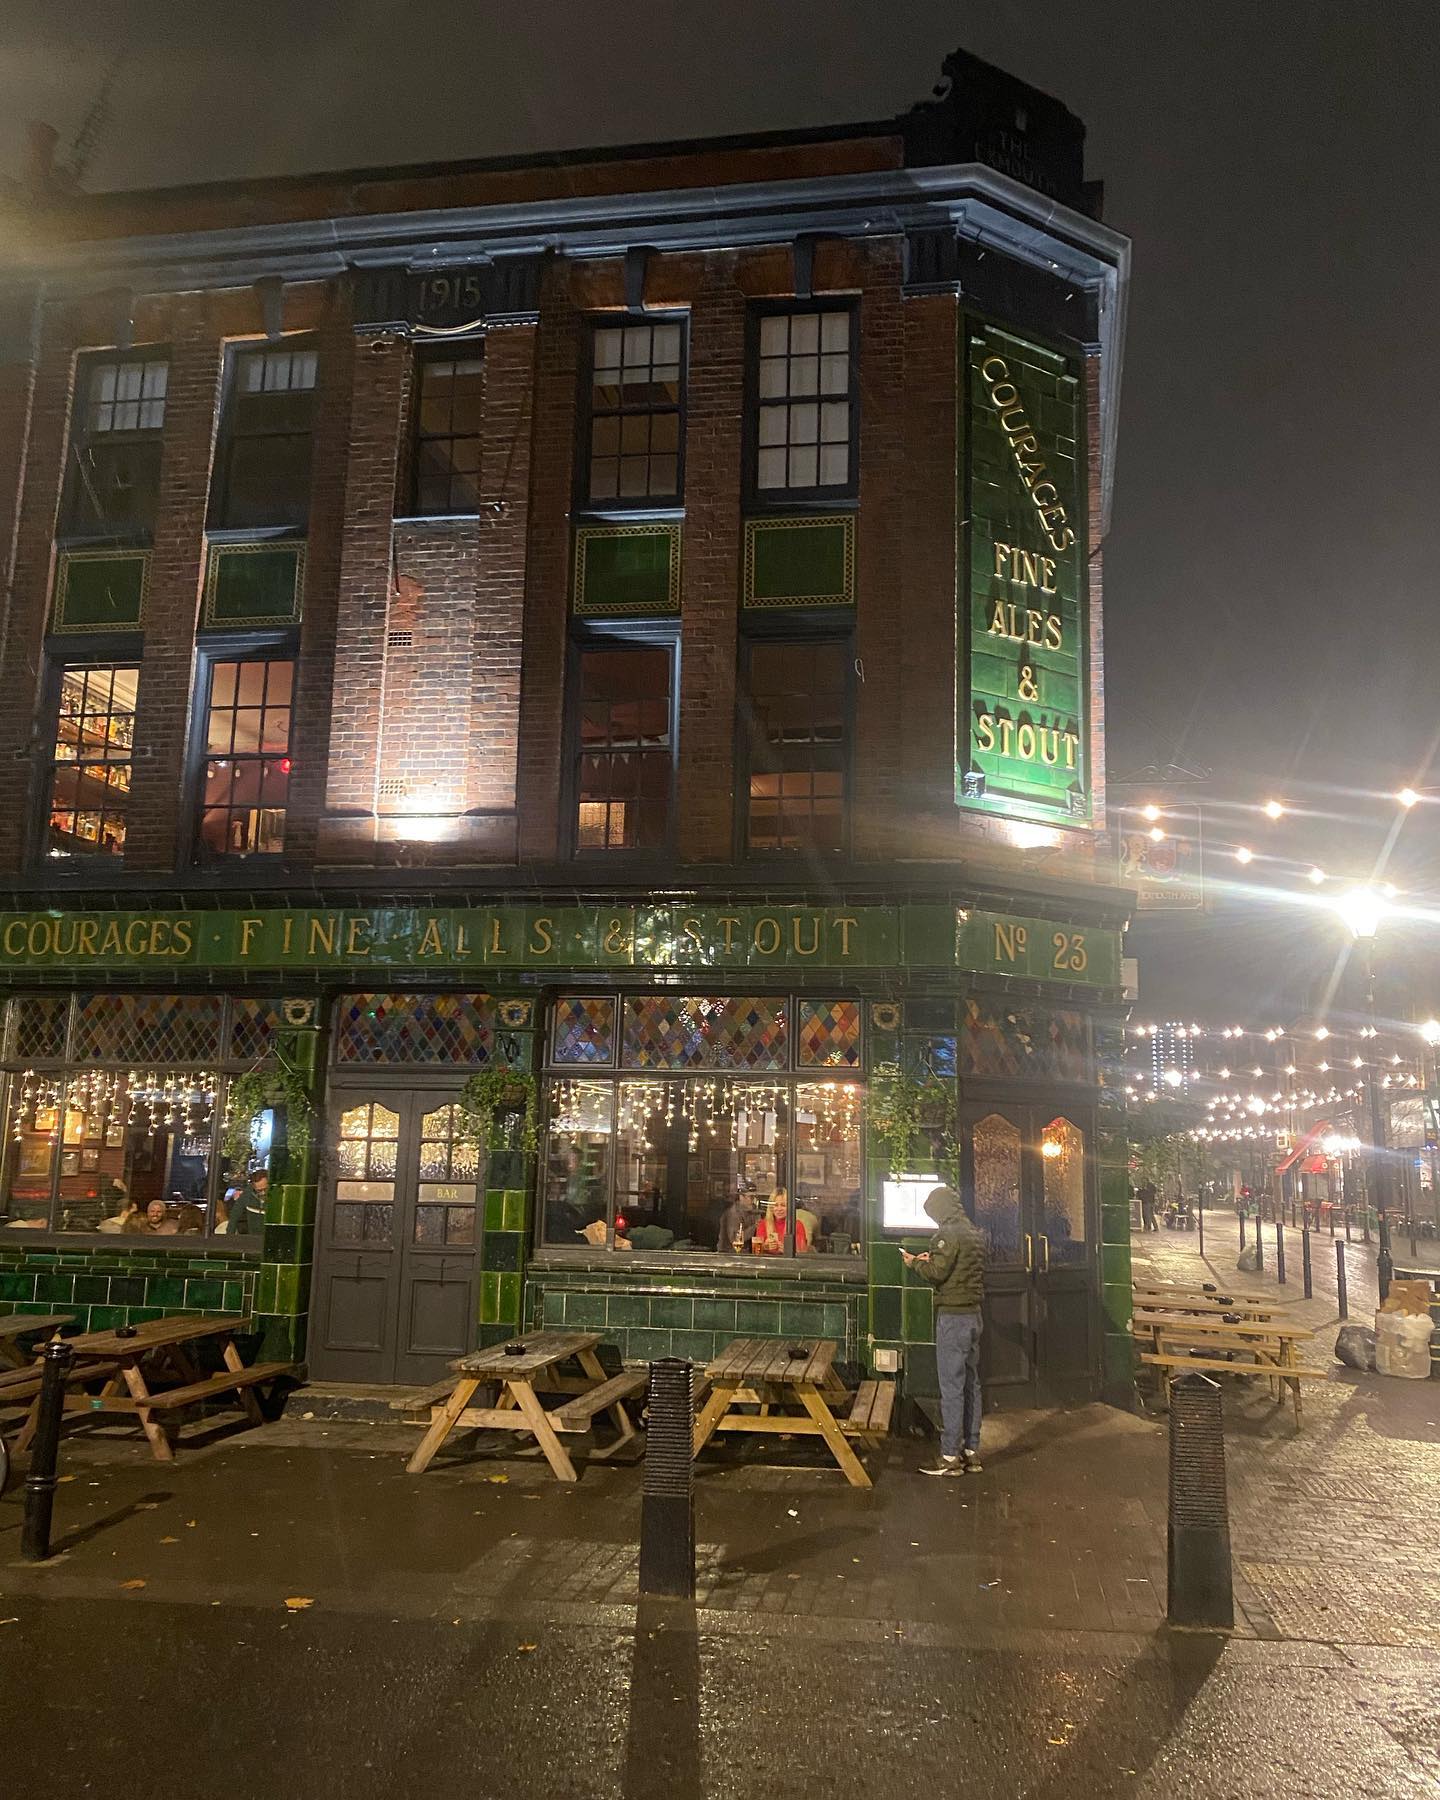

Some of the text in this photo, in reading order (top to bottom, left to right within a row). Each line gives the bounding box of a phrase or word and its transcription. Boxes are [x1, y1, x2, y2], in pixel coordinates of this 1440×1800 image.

[421, 276, 481, 311] 1915
[981, 355, 1075, 553] COURAGES
[993, 542, 1057, 595] FINE
[987, 600, 1063, 651] ALES
[1018, 665, 1039, 703] &
[977, 714, 1079, 771] STOUT
[3, 919, 193, 956] COURAGES
[239, 918, 371, 956] FINE
[603, 917, 634, 955] &
[683, 917, 859, 956] STOUT
[1053, 932, 1088, 972] 23
[436, 1188, 459, 1199] BAR
